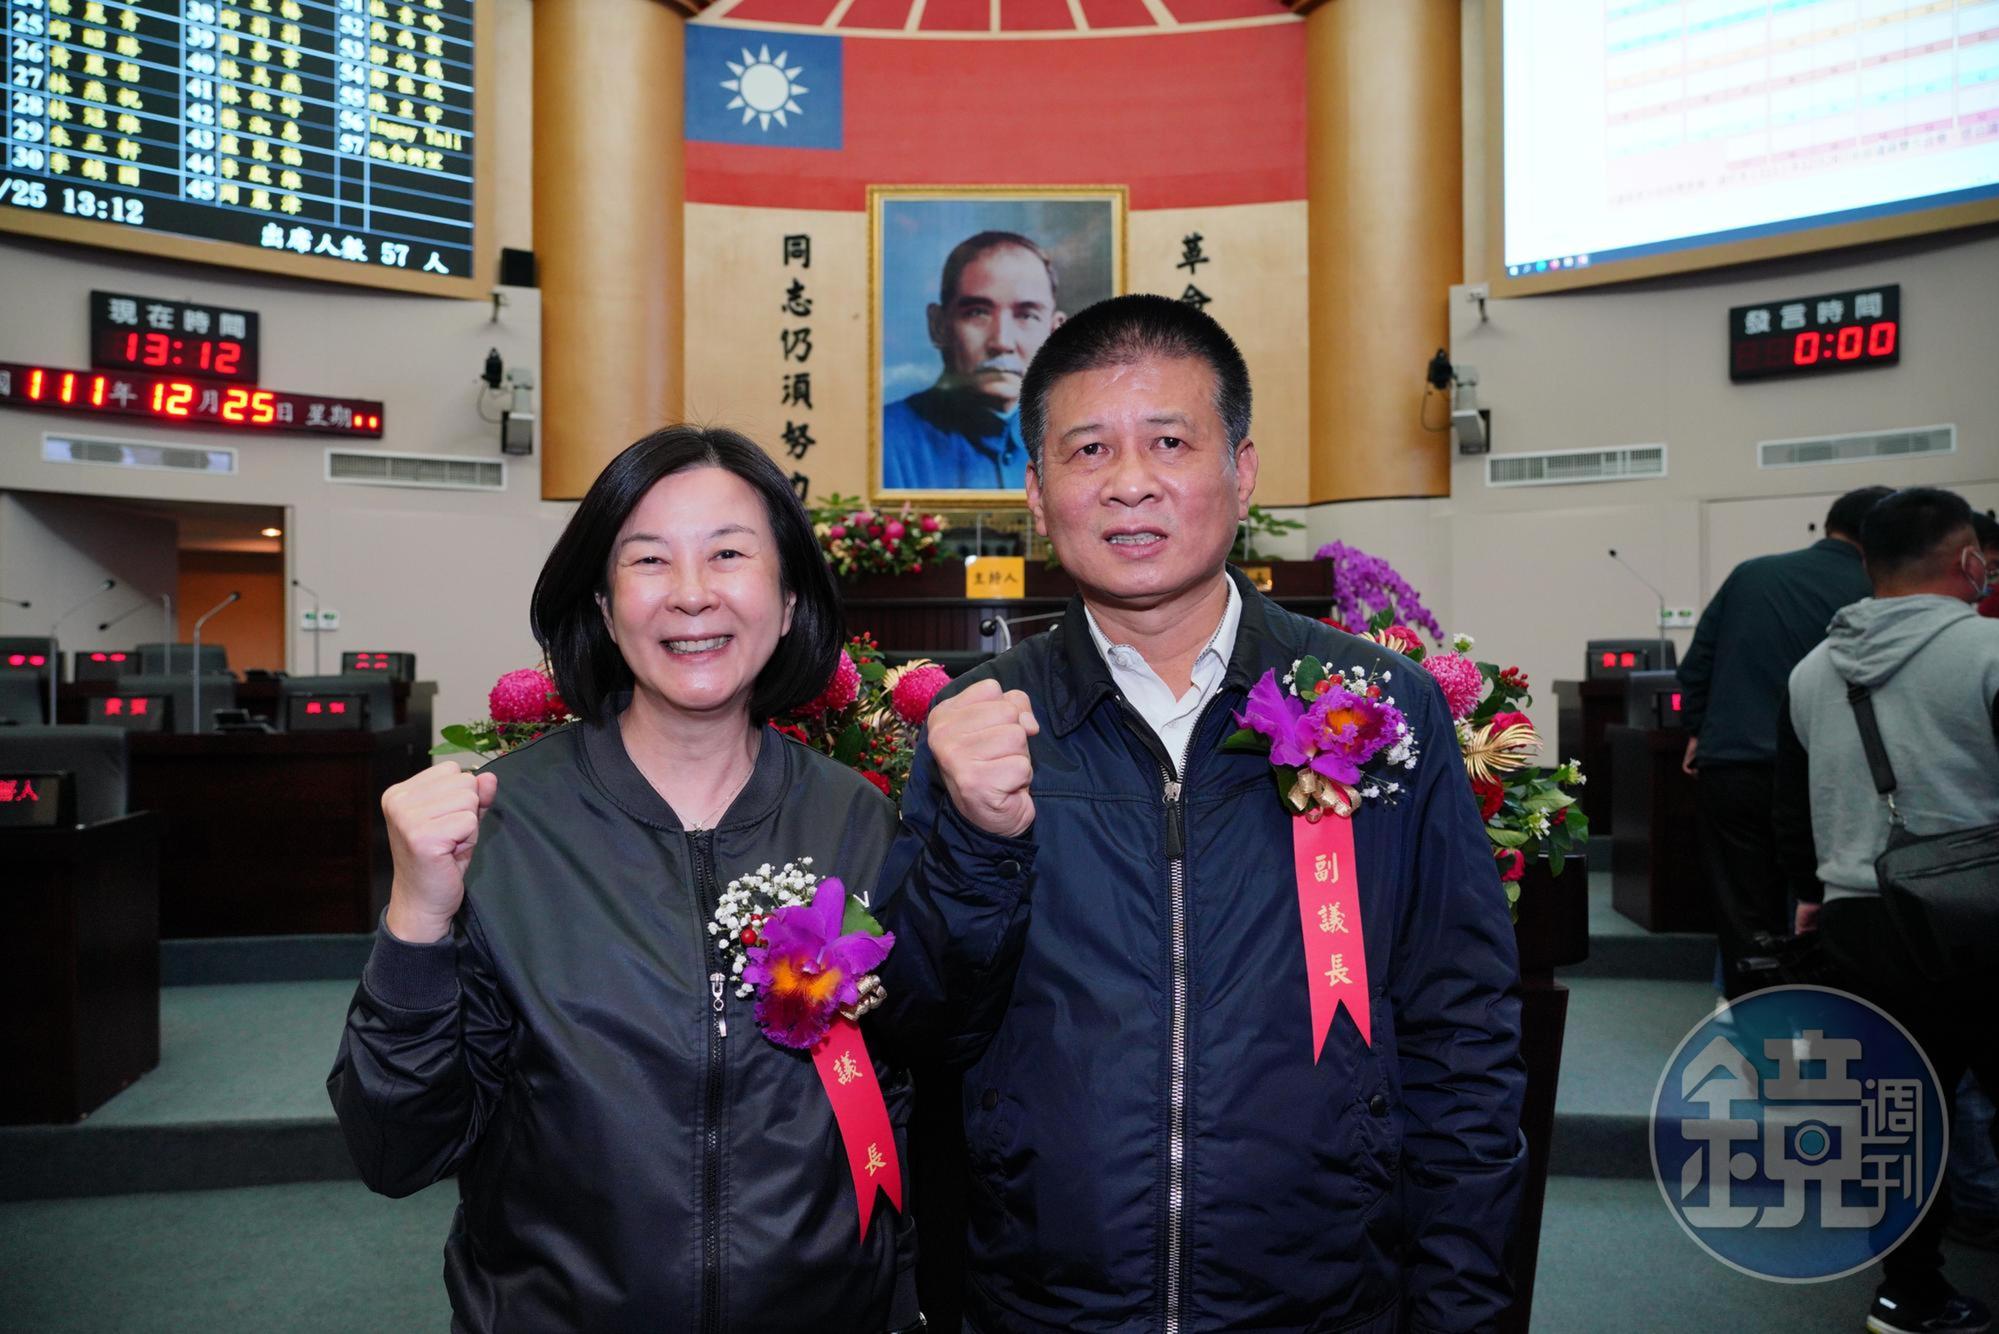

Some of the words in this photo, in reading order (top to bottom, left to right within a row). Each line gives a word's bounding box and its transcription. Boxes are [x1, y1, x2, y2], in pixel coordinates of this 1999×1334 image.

[13, 10, 44, 36] 25
[13, 38, 44, 63] 26
[13, 64, 44, 89] 27
[186, 102, 214, 125] 42
[13, 118, 44, 142] 29
[340, 132, 365, 155] 57
[12, 146, 44, 170] 30
[186, 153, 215, 175] 44
[186, 178, 215, 201] 45
[62, 187, 144, 225] 13:12
[381, 242, 409, 267] 57
[423, 252, 449, 274] 人
[108, 297, 246, 340] 現在時間
[1744, 292, 1883, 336] 發言時間
[125, 331, 241, 375] 13:12
[1793, 321, 1897, 367] 0:00
[1314, 851, 1353, 987] 副議長
[833, 1050, 887, 1177] 議長
